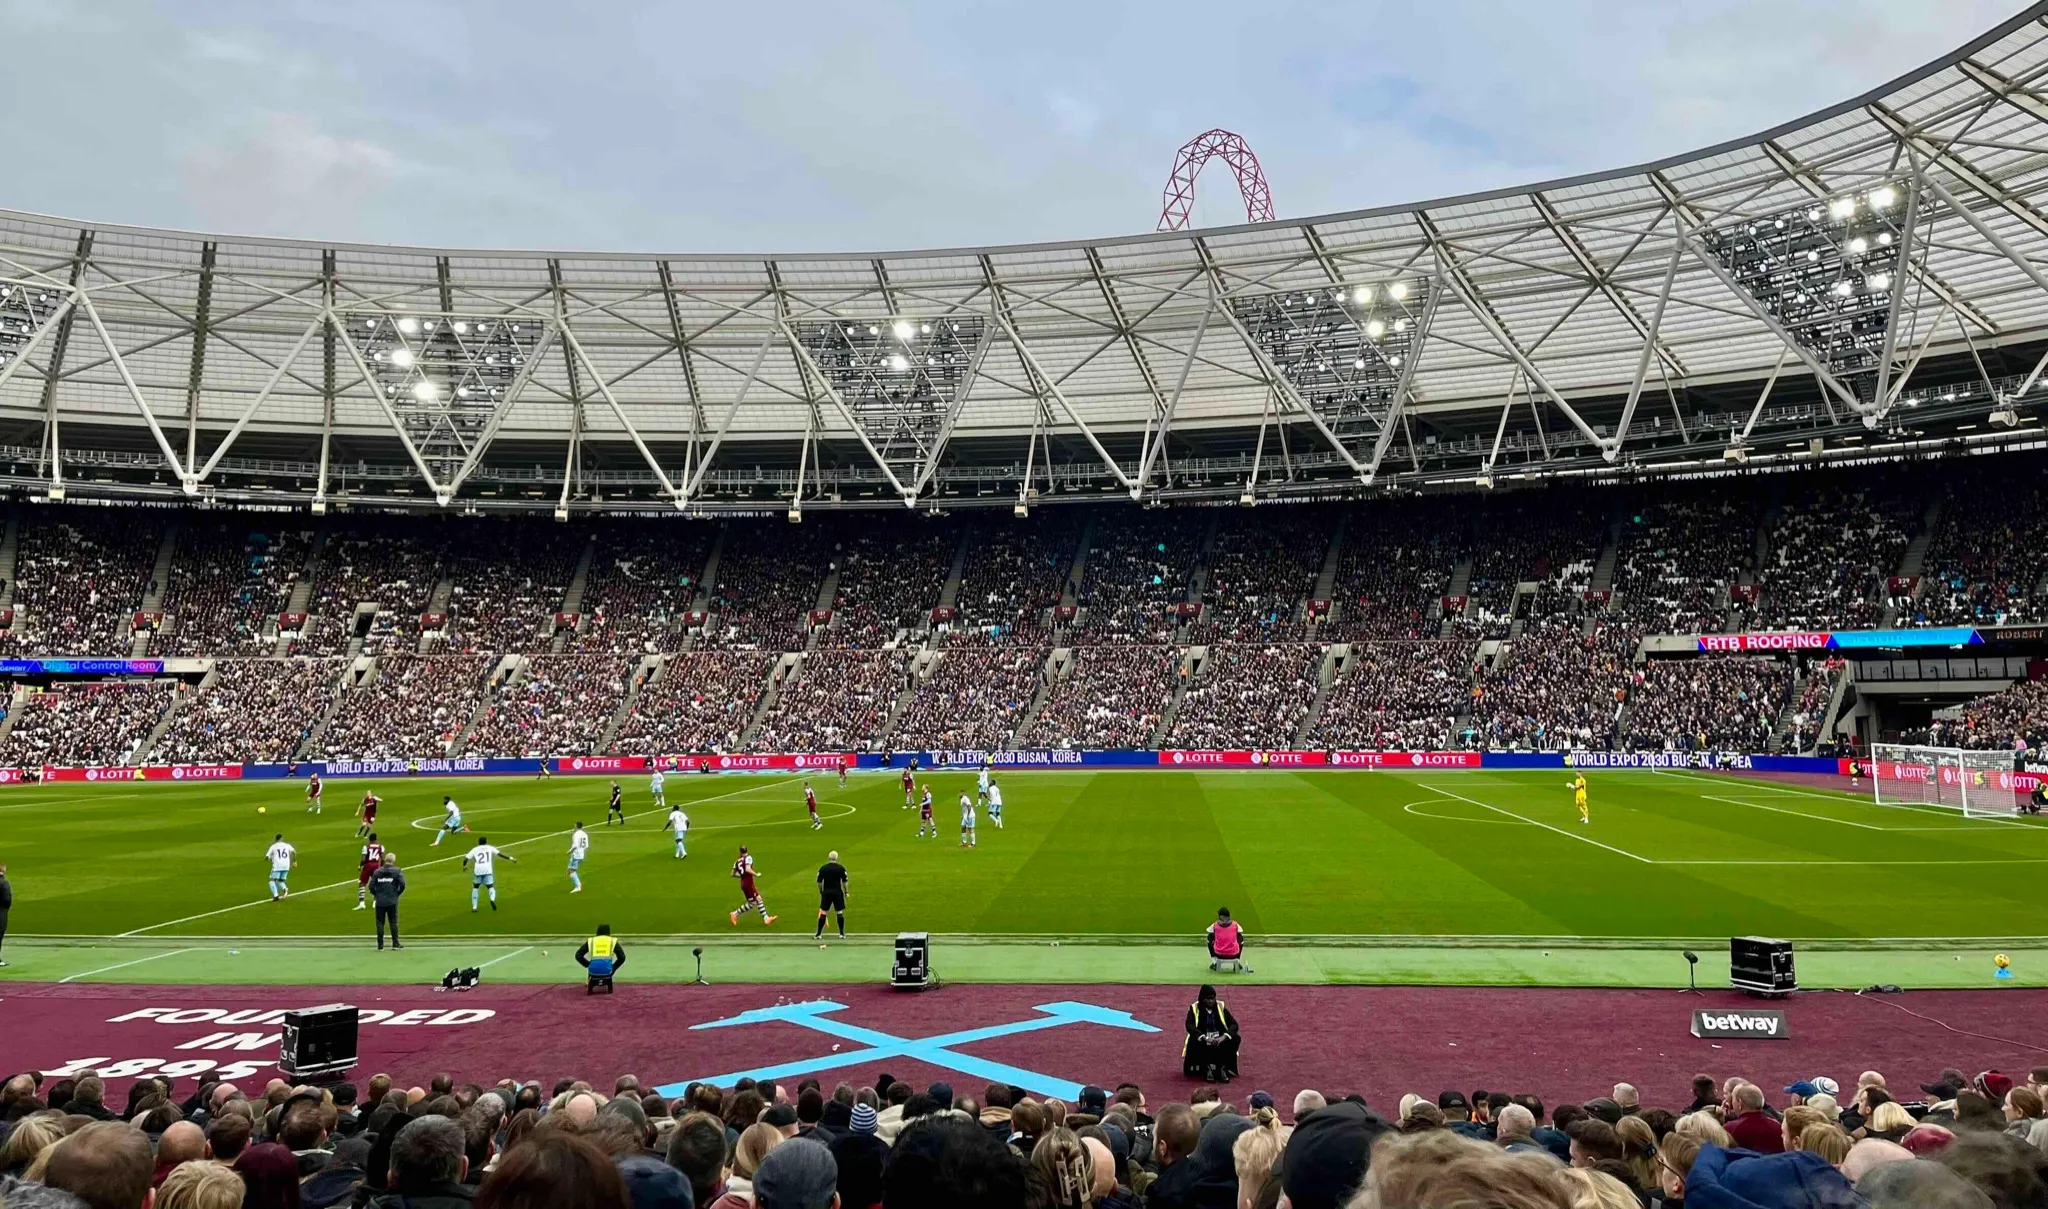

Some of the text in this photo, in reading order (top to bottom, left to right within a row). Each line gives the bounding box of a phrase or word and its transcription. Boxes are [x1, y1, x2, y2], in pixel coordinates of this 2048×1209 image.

[1707, 635, 1822, 649] RTB ROOFING
[82, 661, 123, 670] Control
[125, 661, 156, 670] Room
[585, 759, 621, 768] LOTTE
[733, 757, 769, 766] LOTTE
[932, 752, 964, 764] WRLD
[993, 752, 1015, 764] 2030
[1017, 752, 1050, 765] BUSAN,
[1052, 751, 1082, 763] KOREA
[1186, 753, 1223, 762] LOTTE
[1269, 754, 1302, 762] OTTE
[1344, 754, 1383, 763] LOTTE
[1425, 755, 1467, 764] LOTTE
[1610, 753, 1639, 766] EXPO
[1715, 755, 1753, 769] KREA
[186, 768, 228, 777] LOTTE
[326, 762, 362, 774] WORLD
[363, 761, 389, 773] EXPO
[391, 760, 409, 772] 203
[417, 760, 452, 773] BUSAN,
[454, 759, 484, 771] KOREA
[100, 770, 134, 779] LOTT
[1902, 767, 1926, 779] LOTTE
[579, 837, 586, 849] 15
[276, 849, 288, 859] 16
[369, 848, 380, 861] 14
[477, 851, 490, 864] 21
[737, 861, 745, 875] 5
[105, 1007, 496, 1025] FOUDED
[1702, 1013, 1779, 1035] betway
[173, 1032, 283, 1051] IN
[39, 1057, 278, 1081] 1895
